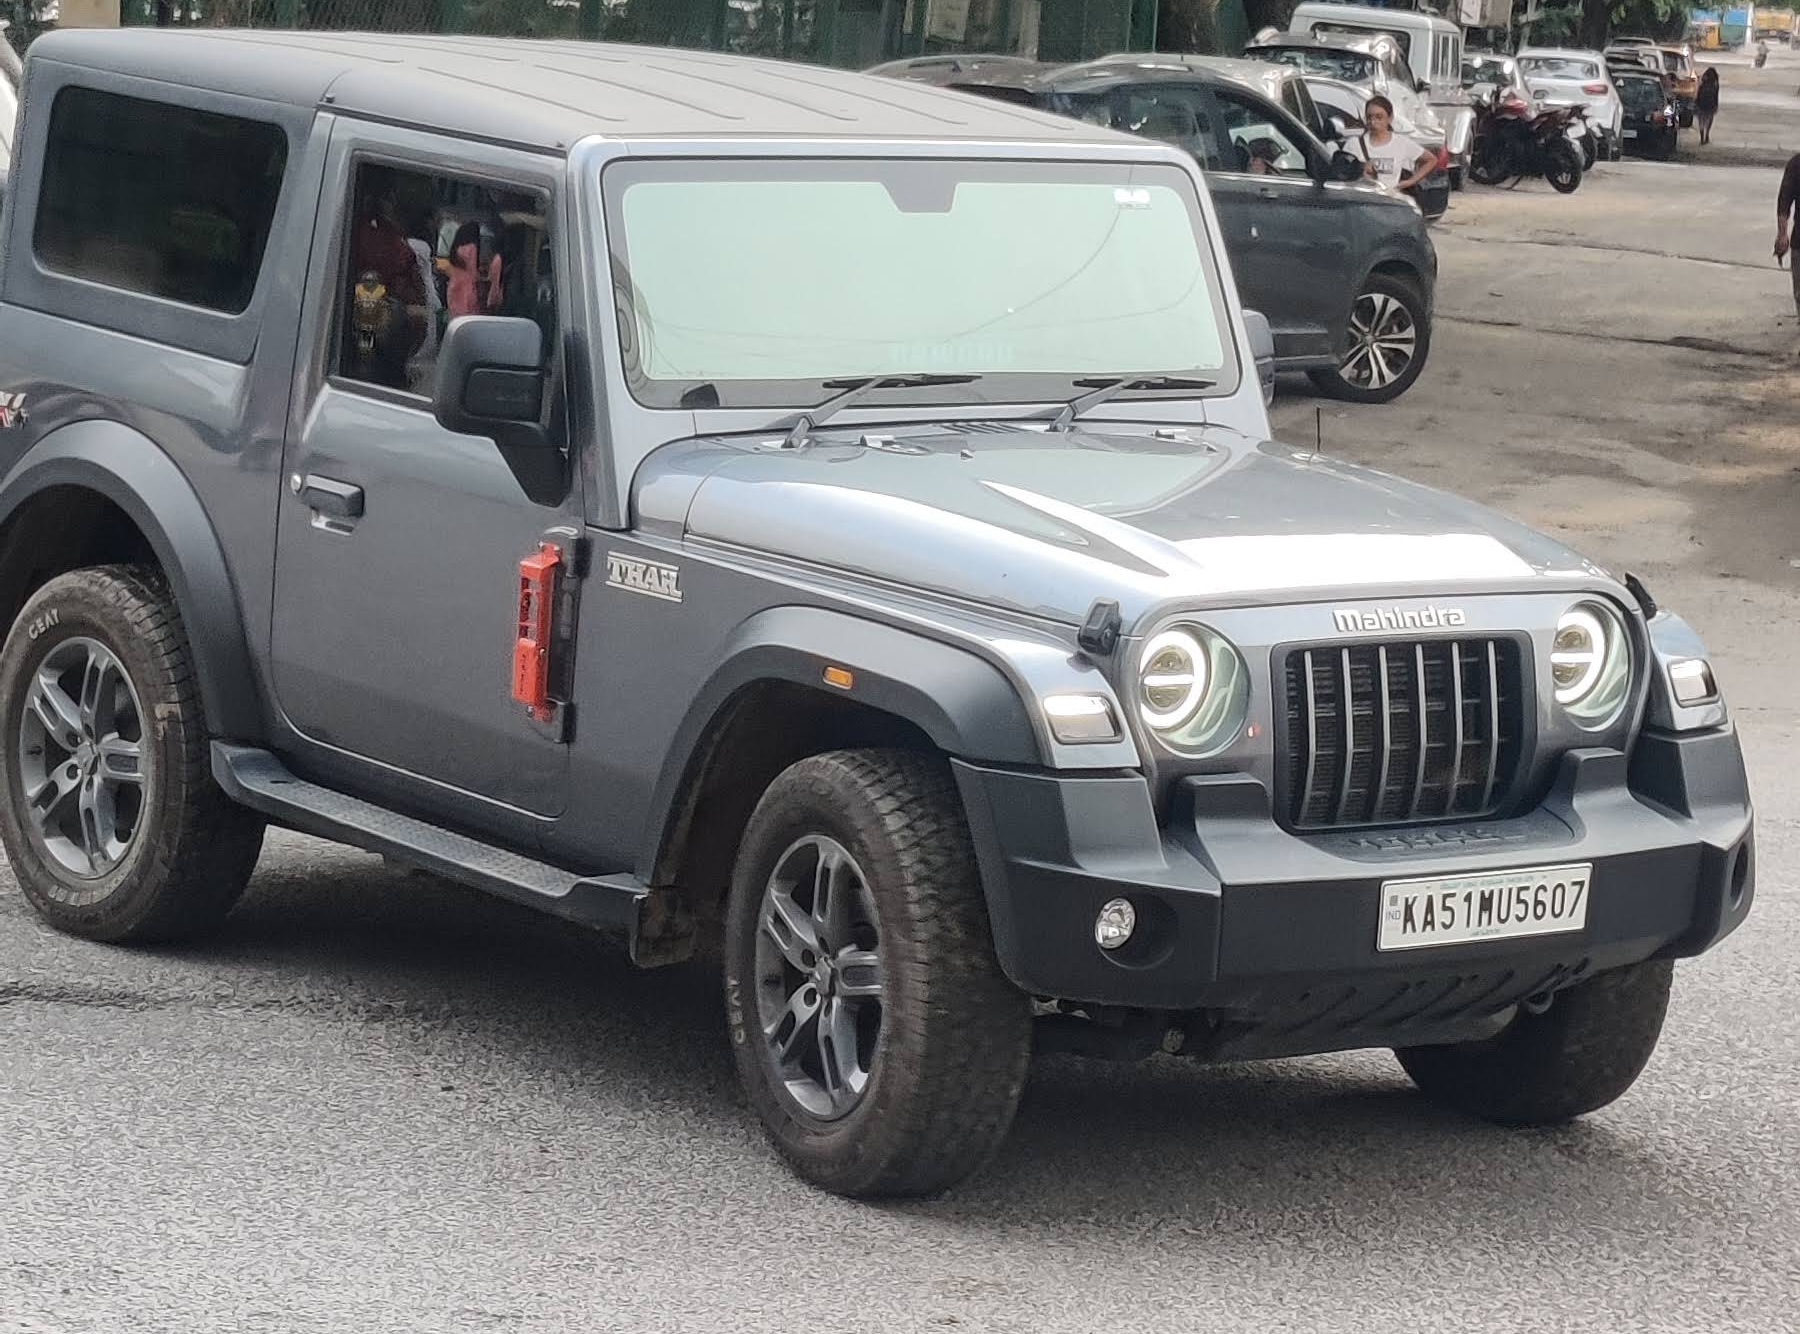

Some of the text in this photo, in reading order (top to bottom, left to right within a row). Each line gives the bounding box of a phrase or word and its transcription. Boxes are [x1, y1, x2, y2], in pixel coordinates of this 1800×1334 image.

[607, 555, 684, 598] THAR
[29, 608, 60, 639] CEAT
[1402, 880, 1586, 935] KA51MU5607
